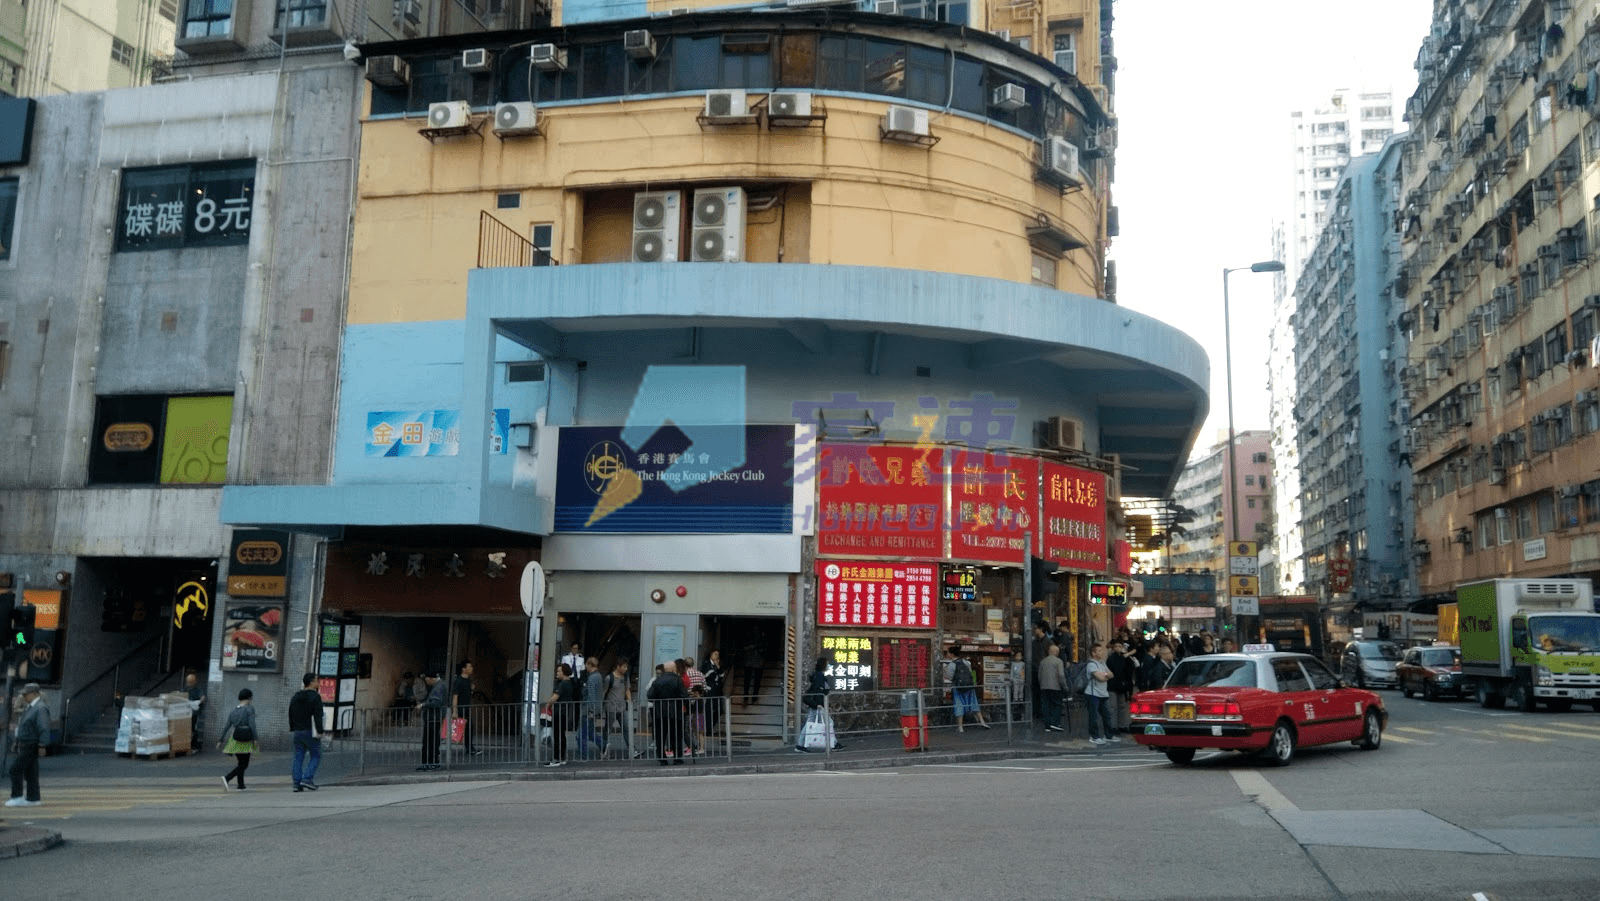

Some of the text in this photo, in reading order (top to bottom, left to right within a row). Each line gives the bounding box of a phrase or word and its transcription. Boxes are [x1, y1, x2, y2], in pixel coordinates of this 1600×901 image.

[125, 198, 250, 237] 碟碟 8元
[638, 452, 711, 464] 香港賽馬會
[637, 470, 765, 484] The Hong Kong Jockey Club
[963, 462, 1026, 500] 許氏
[824, 534, 937, 549] EXCHANGE AND REMITTANCE
[823, 637, 872, 650] 深港兩地
[1245, 643, 1270, 651] TAXI
[834, 650, 859, 663] 物業
[835, 678, 859, 690] 到手
